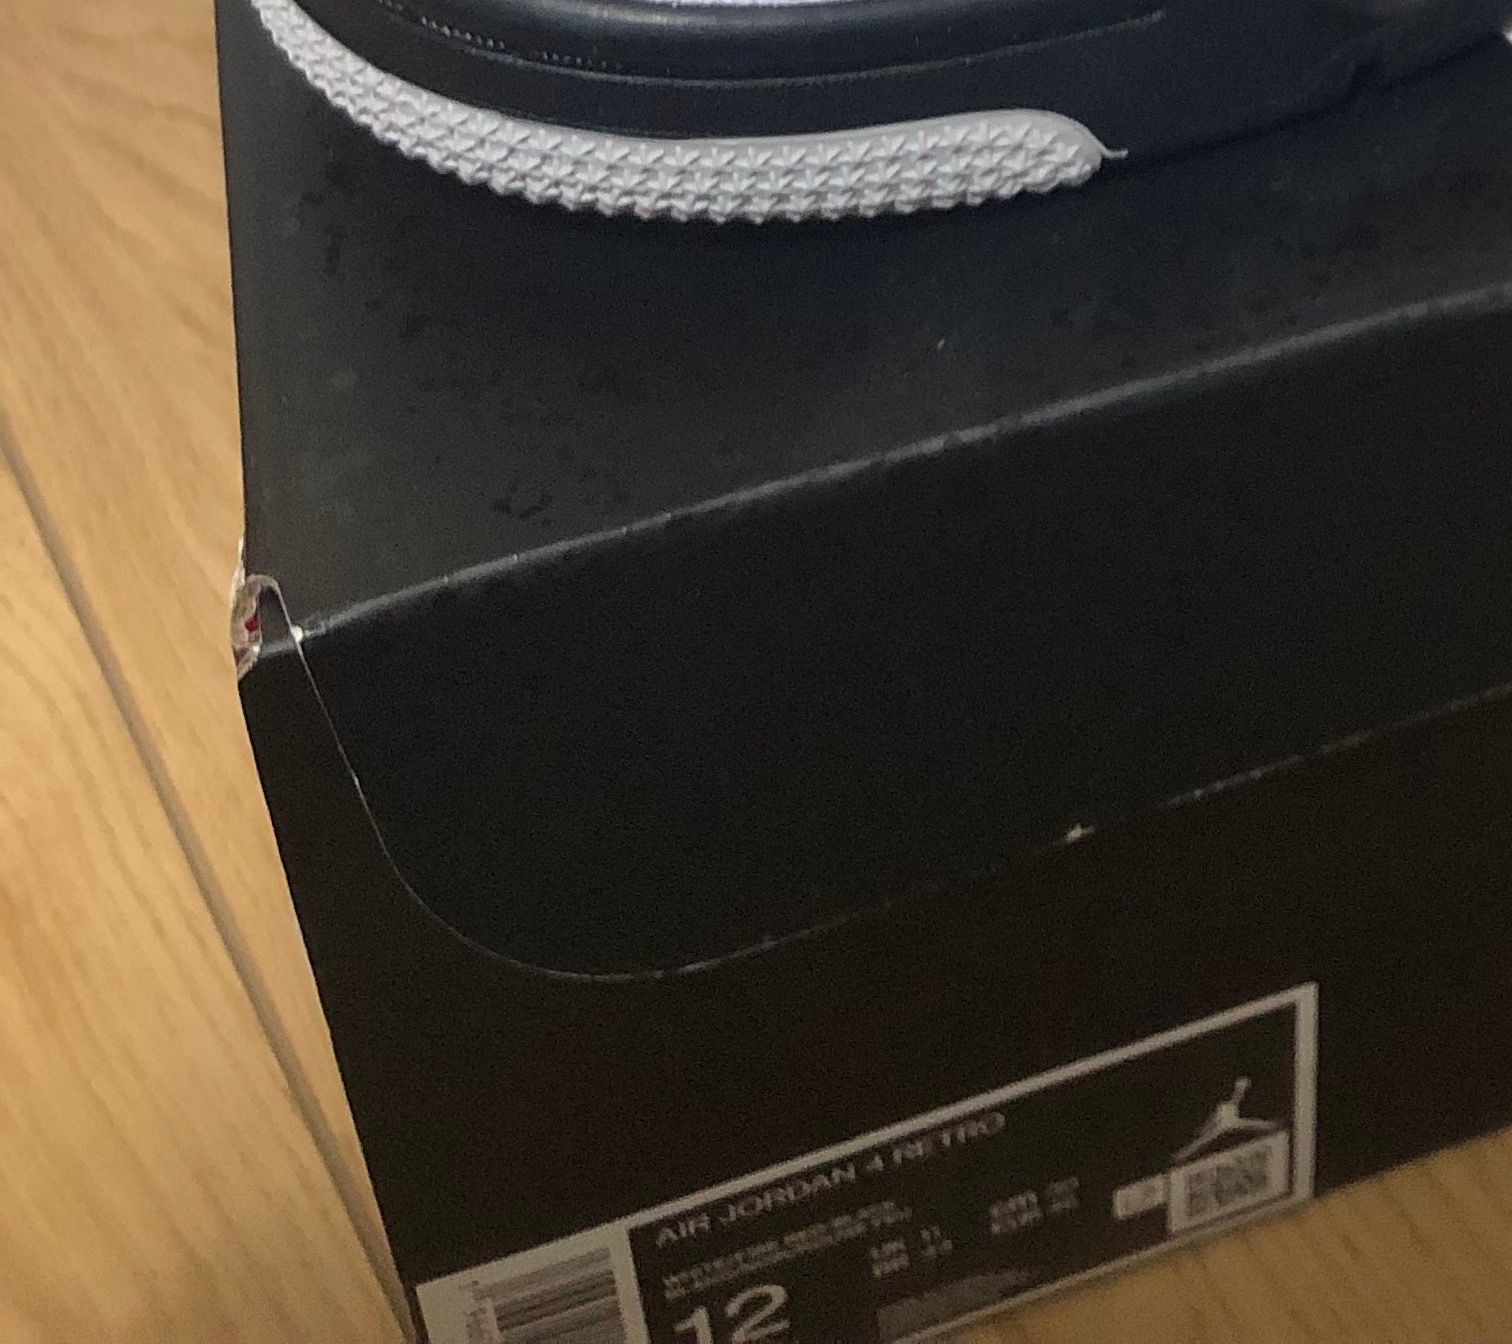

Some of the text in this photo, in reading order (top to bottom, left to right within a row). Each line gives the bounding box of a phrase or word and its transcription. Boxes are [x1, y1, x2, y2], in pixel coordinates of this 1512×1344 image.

[656, 1215, 711, 1249] AIR
[720, 1164, 856, 1225] JORDAN
[893, 1112, 1006, 1164] RETRO
[672, 1284, 790, 1344] 12
